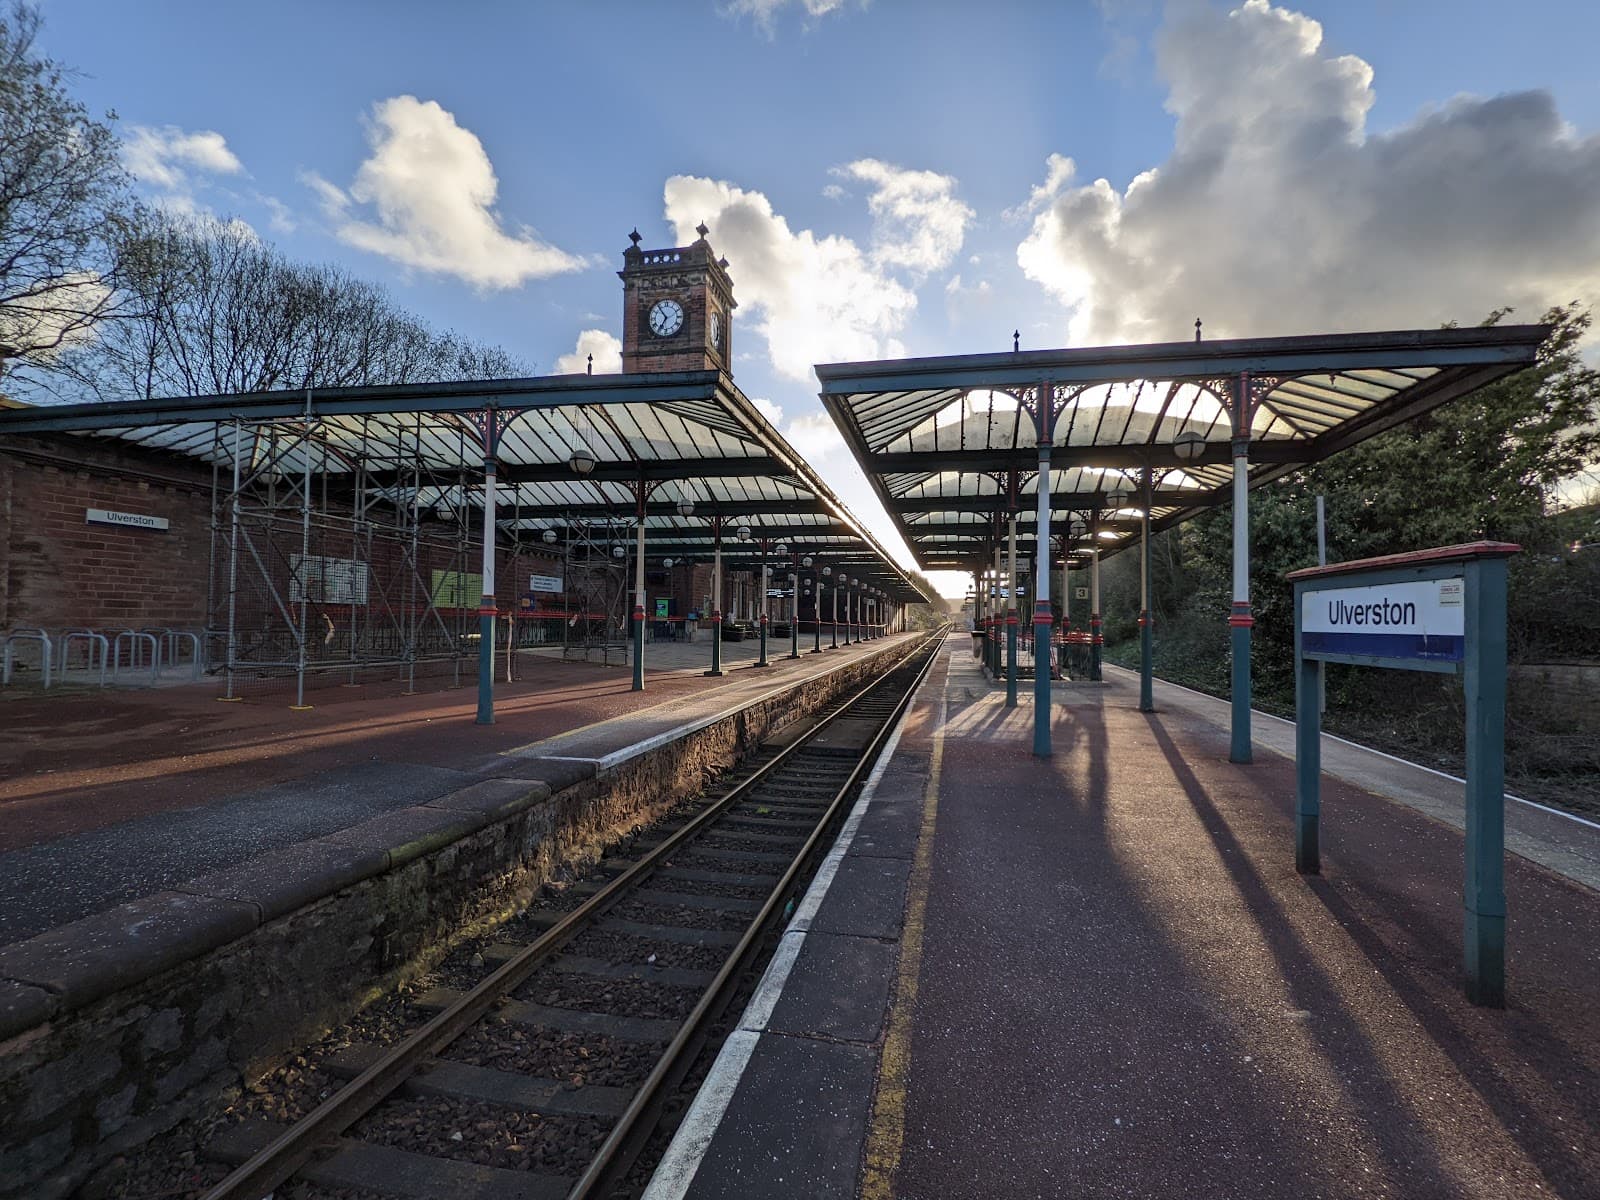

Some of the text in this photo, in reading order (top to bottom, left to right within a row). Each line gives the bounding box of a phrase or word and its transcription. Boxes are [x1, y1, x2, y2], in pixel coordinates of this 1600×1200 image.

[107, 512, 154, 525] Ulverston
[1078, 589, 1086, 598] 3
[1328, 598, 1416, 625] Ulverston
